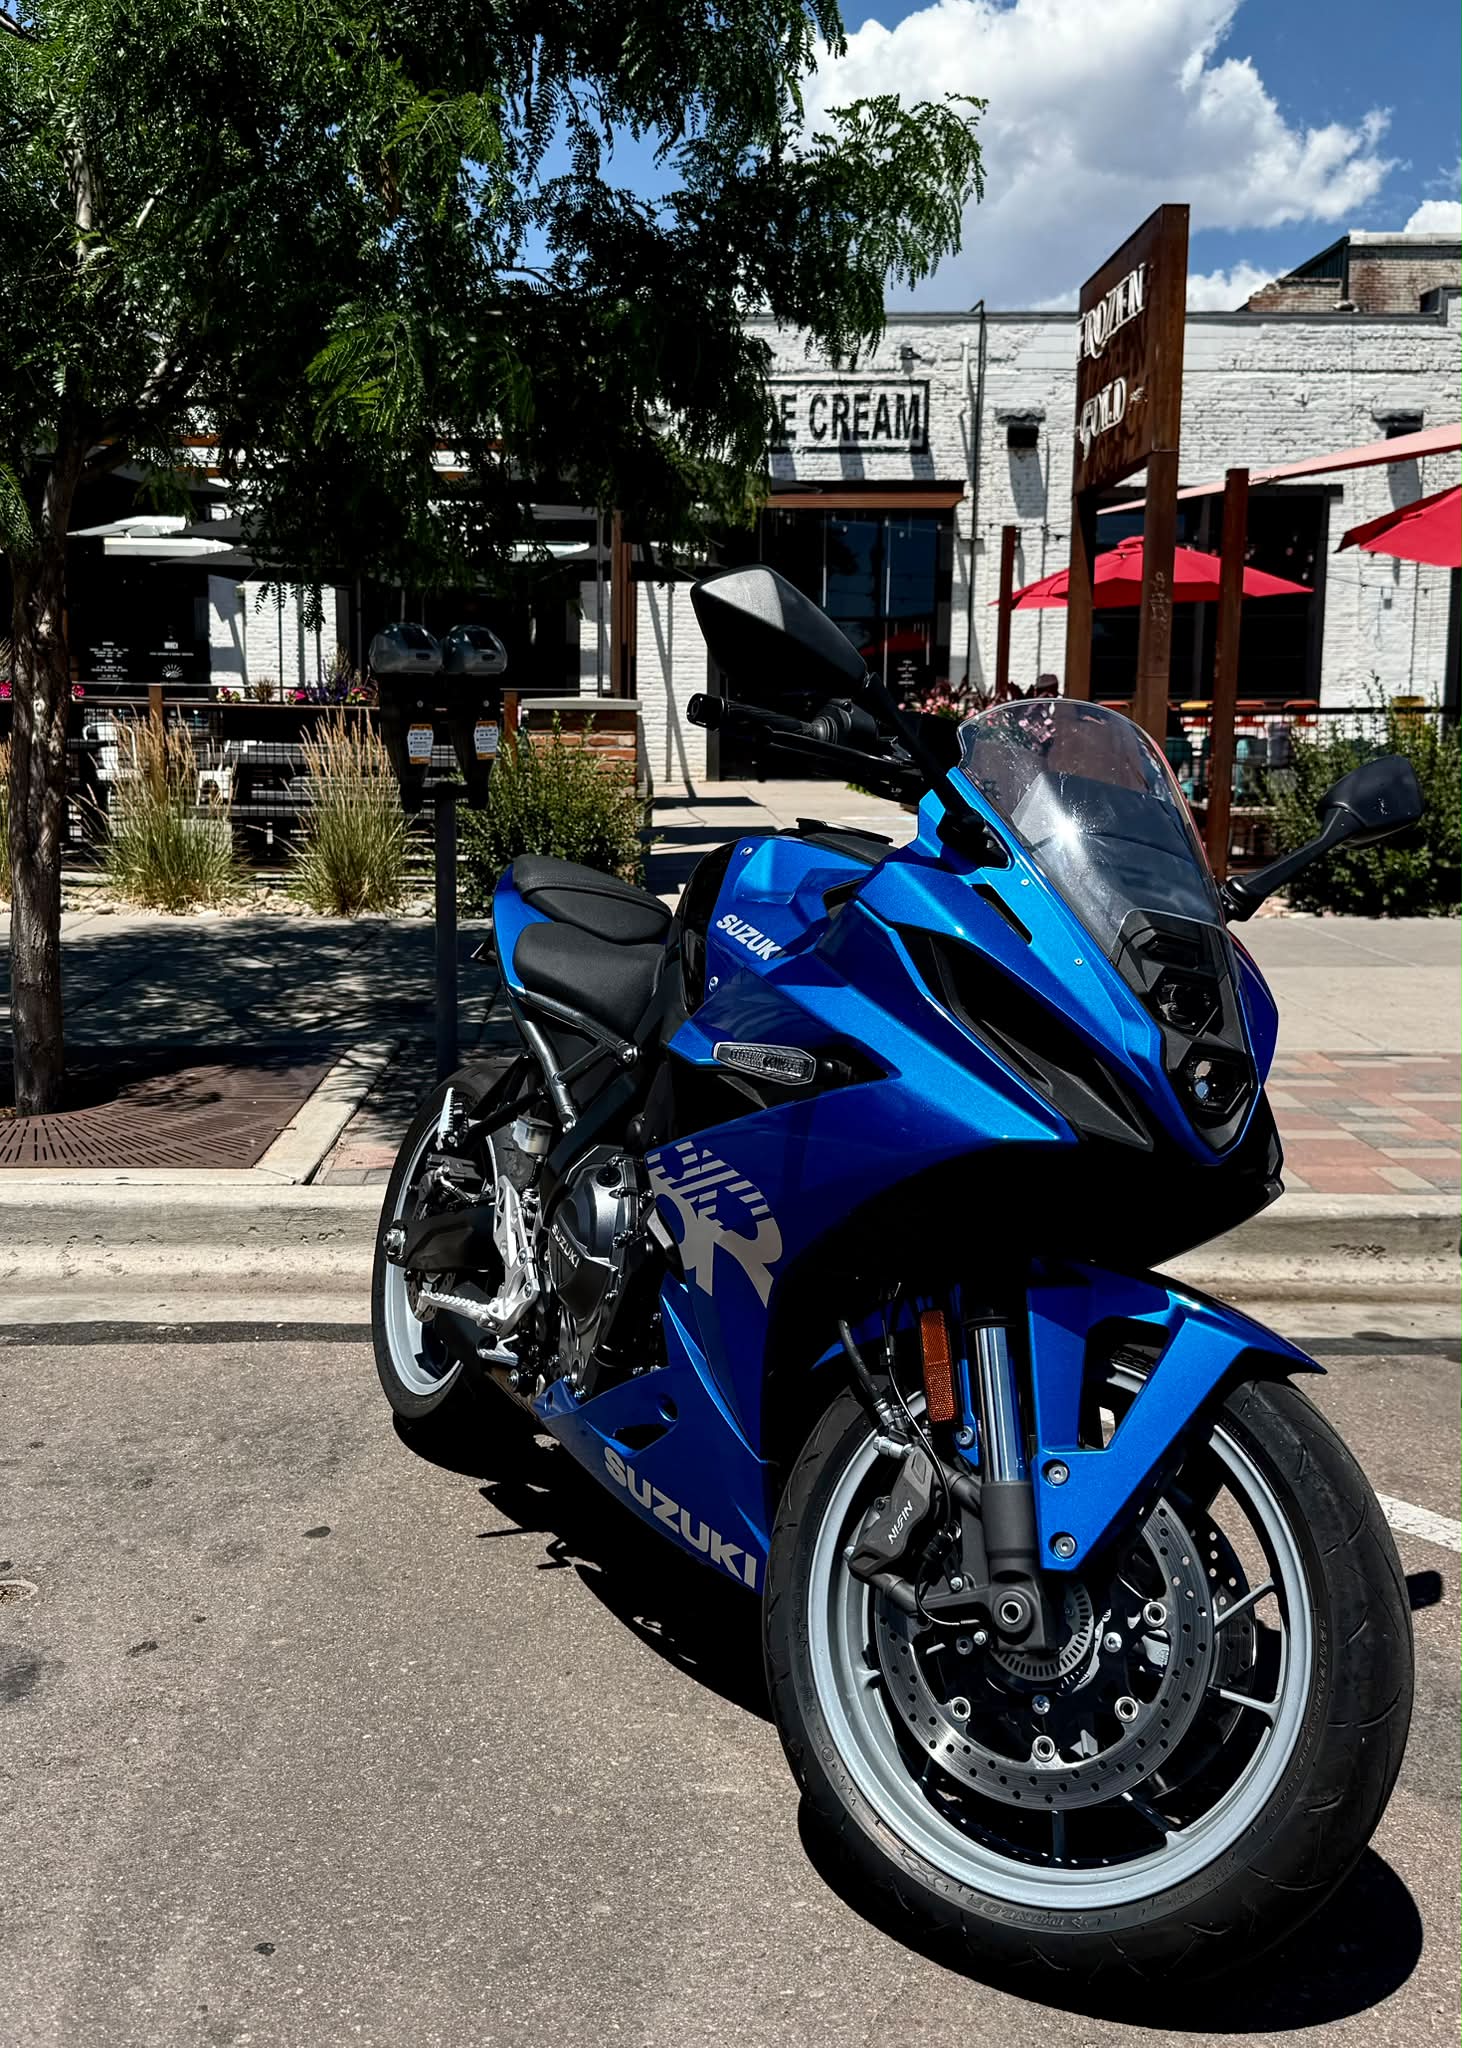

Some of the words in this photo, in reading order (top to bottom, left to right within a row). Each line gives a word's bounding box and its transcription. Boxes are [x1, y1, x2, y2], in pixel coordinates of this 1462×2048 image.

[1076, 262, 1146, 365] FROZEN
[808, 393, 920, 441] CREAM
[551, 1223, 580, 1268] SUZUKI
[604, 1446, 757, 1590] SUZUKI
